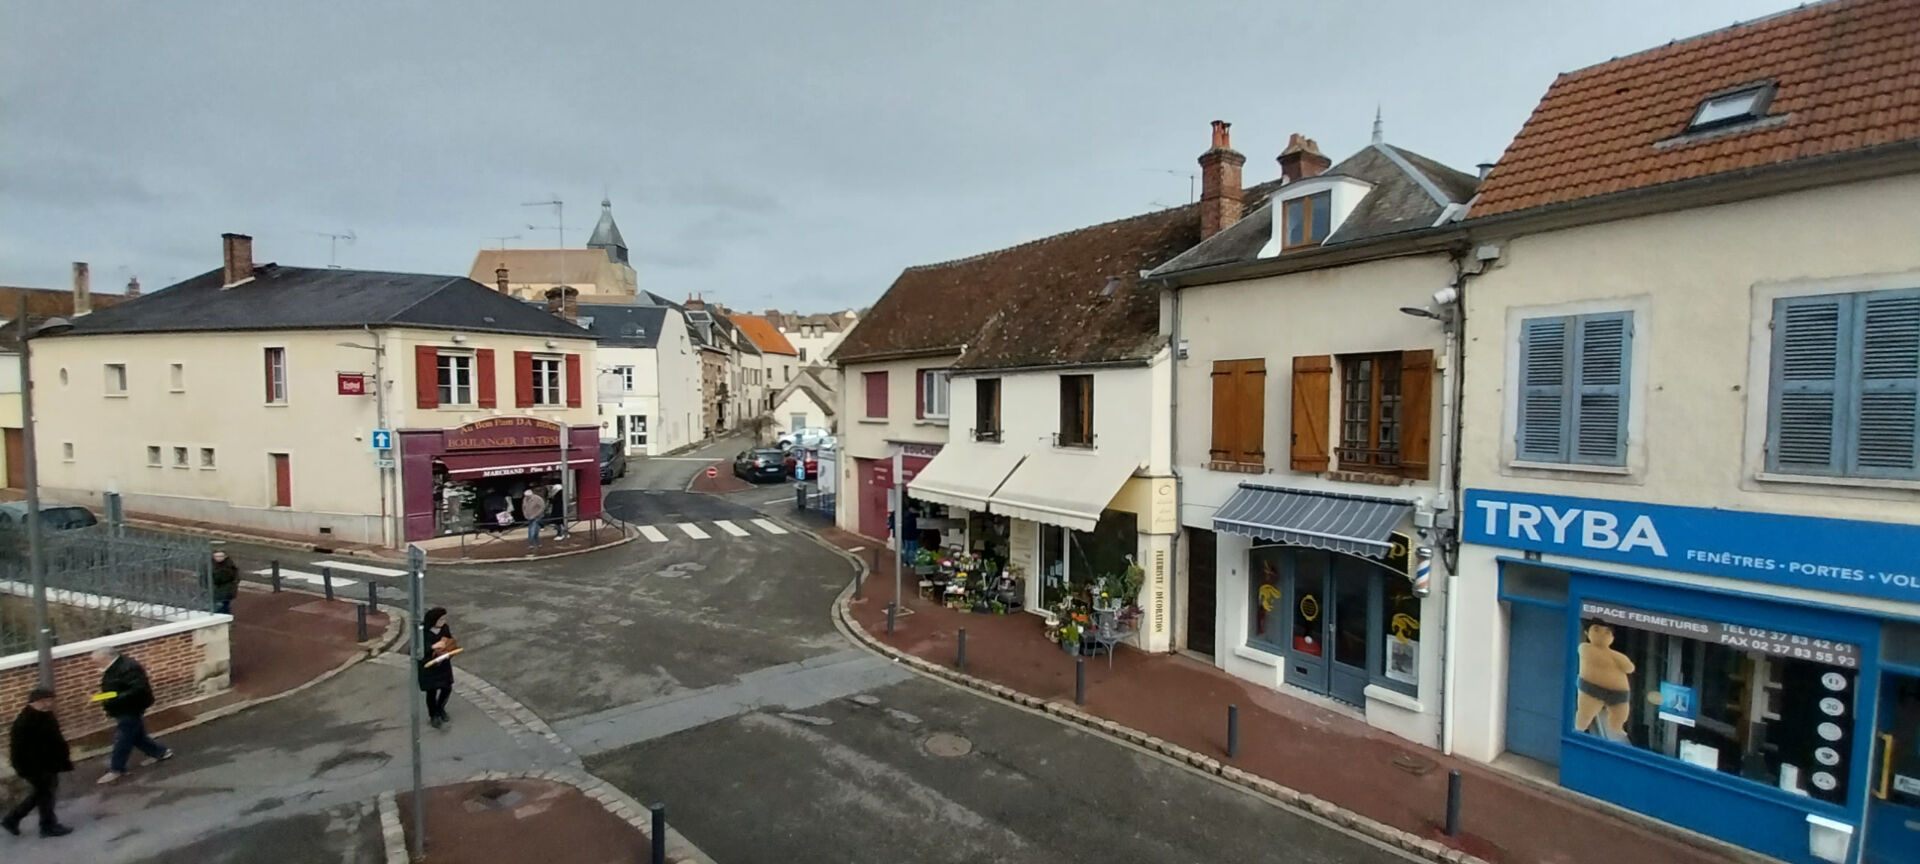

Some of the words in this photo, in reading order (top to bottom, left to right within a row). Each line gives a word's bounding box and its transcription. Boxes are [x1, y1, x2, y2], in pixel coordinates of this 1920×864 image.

[475, 420, 493, 429] Bon
[447, 438, 517, 448] BOULANGER
[483, 468, 524, 477] MARCHAND
[1476, 500, 1669, 557] TRYBA
[1156, 550, 1164, 584] FLEURISTE
[1687, 550, 1776, 570] FENÊTRES
[1789, 562, 1865, 581] PORTES
[1583, 604, 1626, 618] ESPACE
[1628, 613, 1709, 633] FERMETURES
[1721, 623, 1745, 635] TEL
[1749, 628, 1766, 638] 02
[1770, 631, 1788, 641] 37
[1791, 635, 1809, 646] 83
[1813, 640, 1831, 650] 42
[1721, 635, 1749, 647] FAX
[1752, 640, 1769, 651] 02
[1773, 644, 1790, 654] 37
[1794, 648, 1812, 658] 83
[1816, 652, 1834, 662] 55
[1838, 656, 1856, 667] 93
